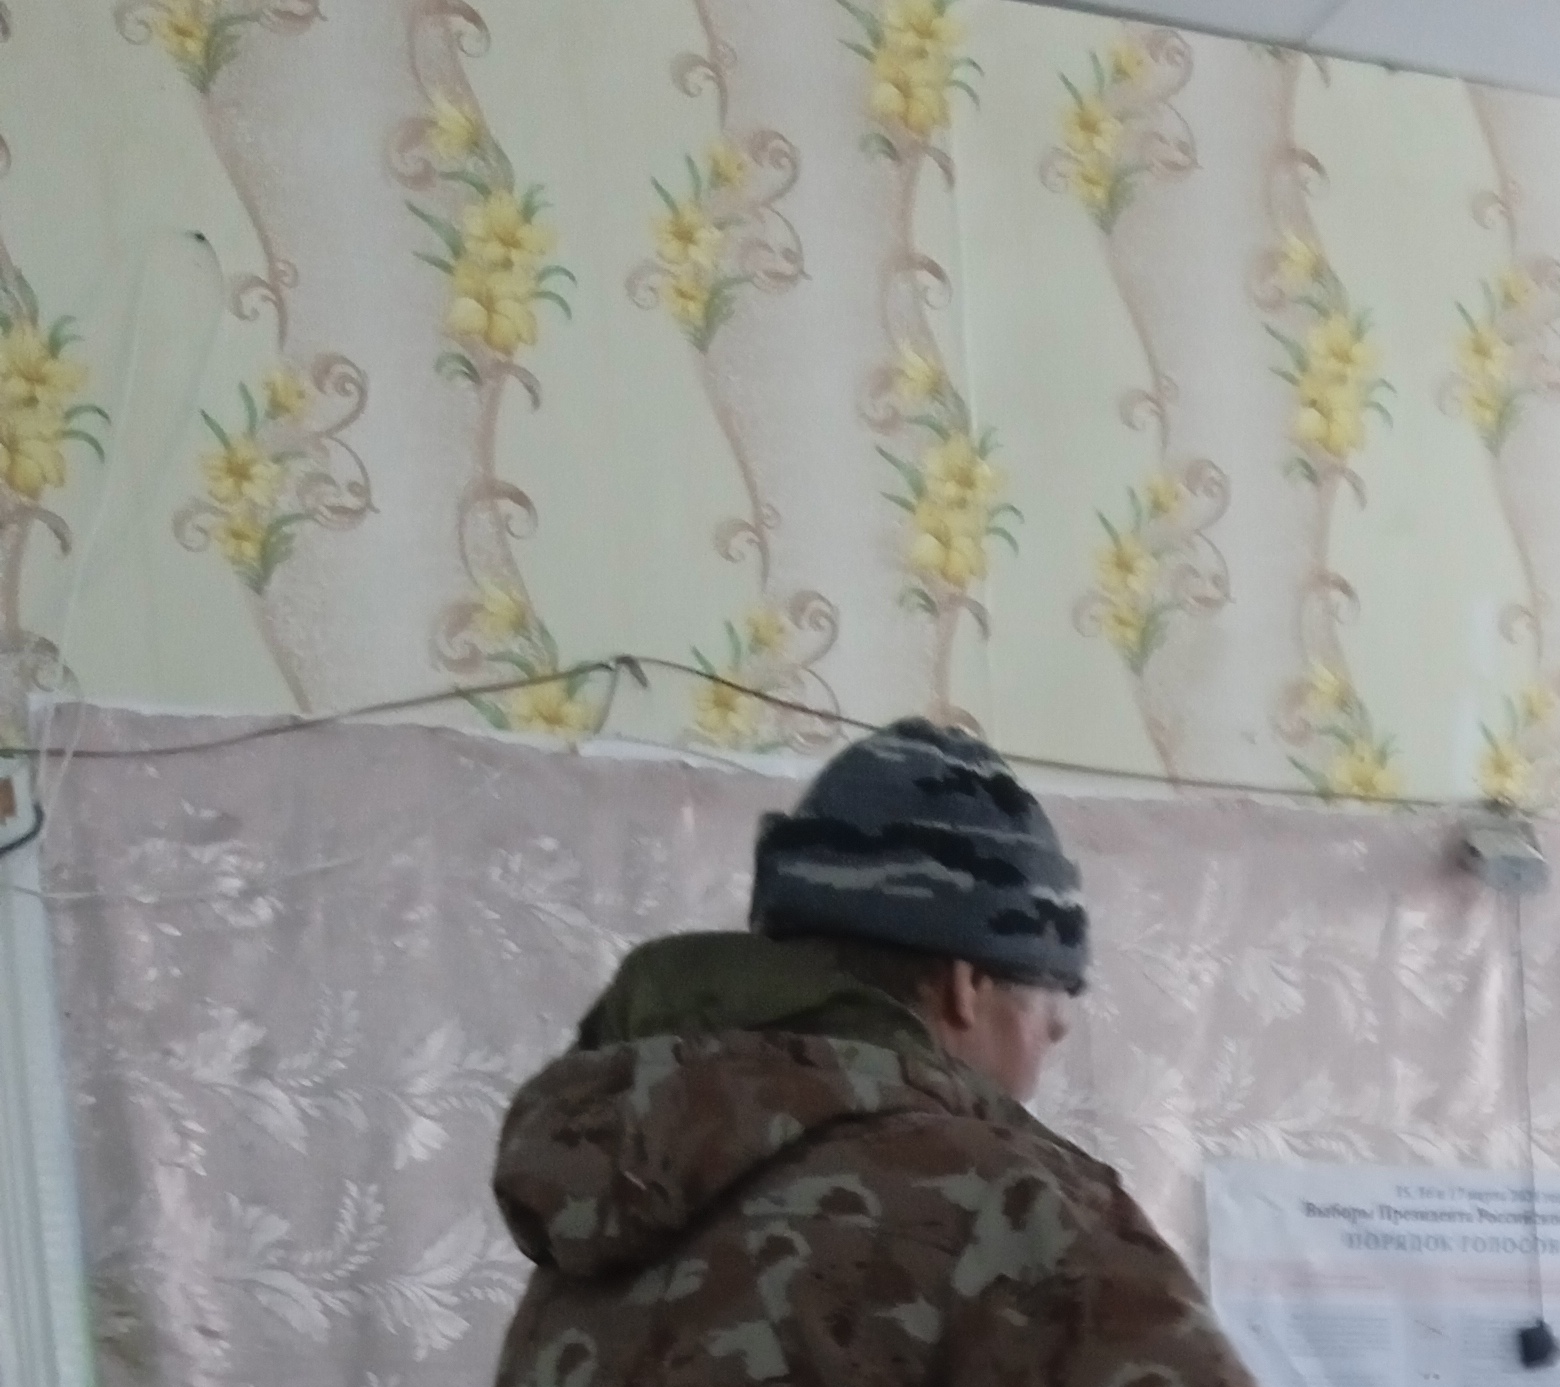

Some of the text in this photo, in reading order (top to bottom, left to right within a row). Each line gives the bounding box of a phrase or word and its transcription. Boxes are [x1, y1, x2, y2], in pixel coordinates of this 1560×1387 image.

[1302, 1200, 1374, 1224] Выборы
[1378, 1204, 1473, 1225] Президента
[1342, 1231, 1452, 1253] ПОРЯДОК
